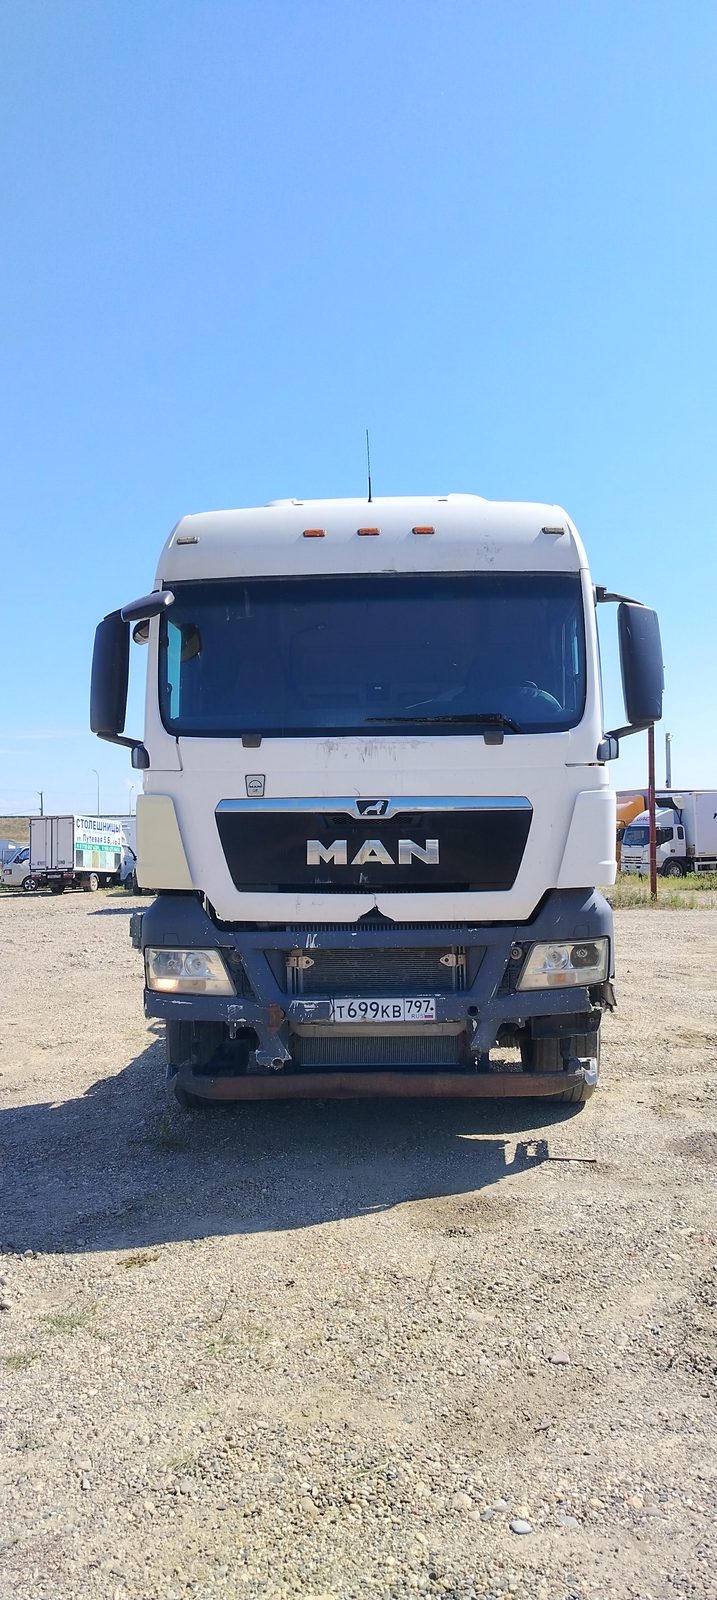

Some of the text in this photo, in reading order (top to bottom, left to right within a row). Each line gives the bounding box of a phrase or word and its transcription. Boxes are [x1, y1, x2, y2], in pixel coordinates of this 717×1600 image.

[76, 818, 121, 833] СТОЛЕШНИЦЫ
[306, 839, 440, 865] MAN
[336, 1000, 431, 1019] Т699КВ 797
